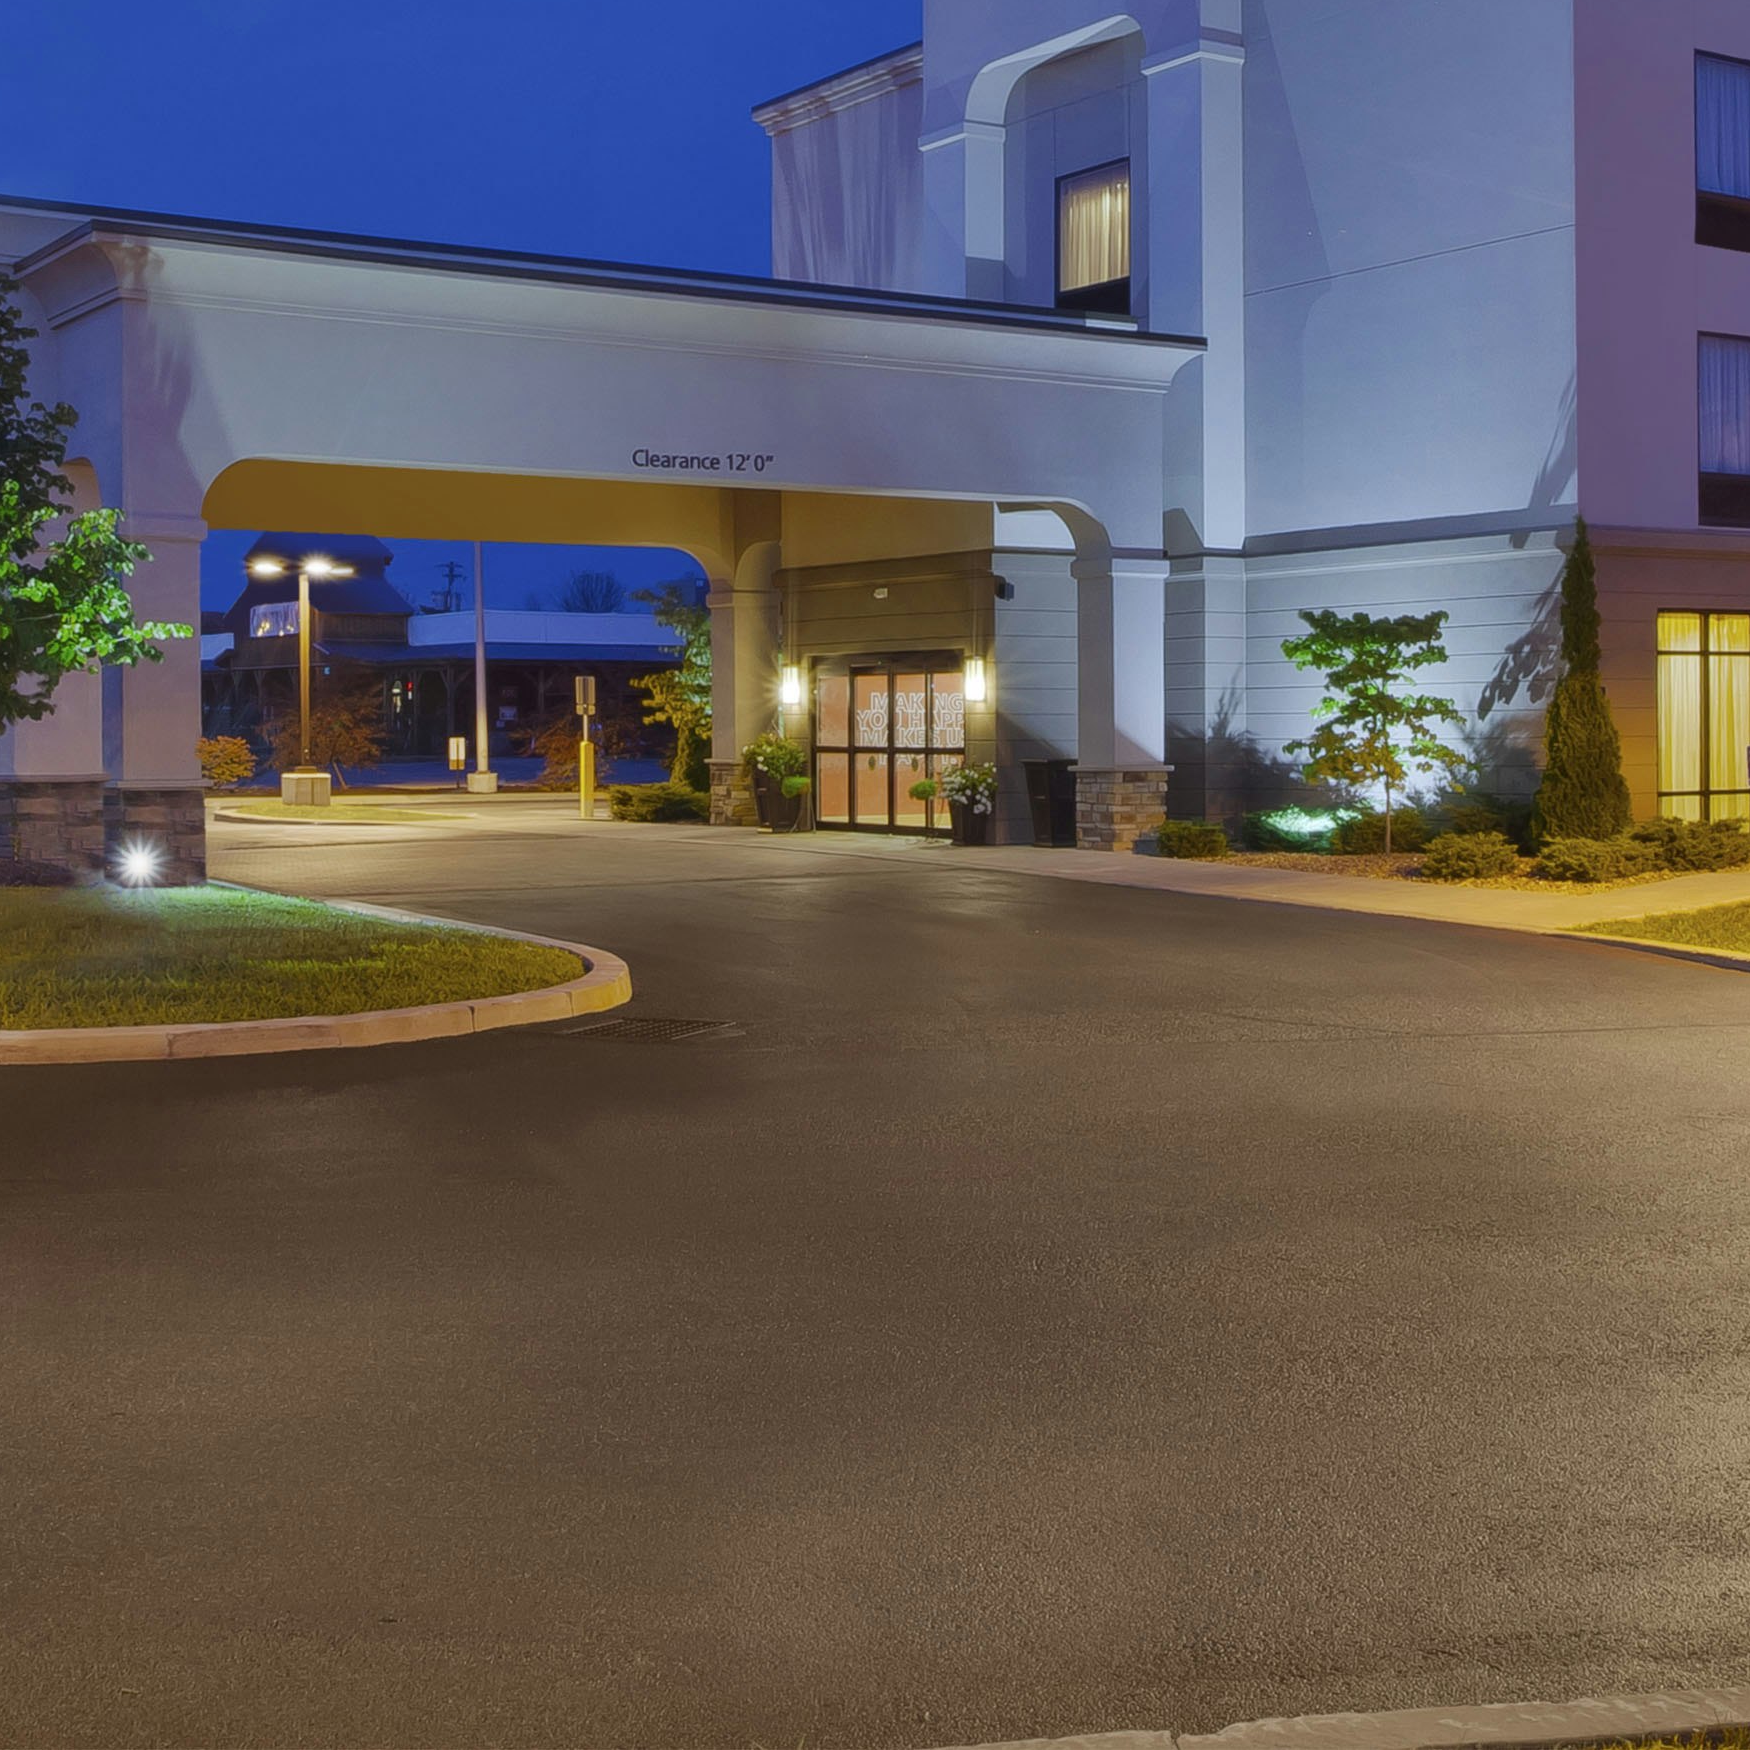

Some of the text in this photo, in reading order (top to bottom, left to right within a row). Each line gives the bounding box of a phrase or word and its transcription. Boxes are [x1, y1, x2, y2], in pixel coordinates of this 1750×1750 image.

[632, 449, 720, 470] Clearance
[871, 692, 964, 713] MAKNG
[908, 710, 965, 731] HAPP
